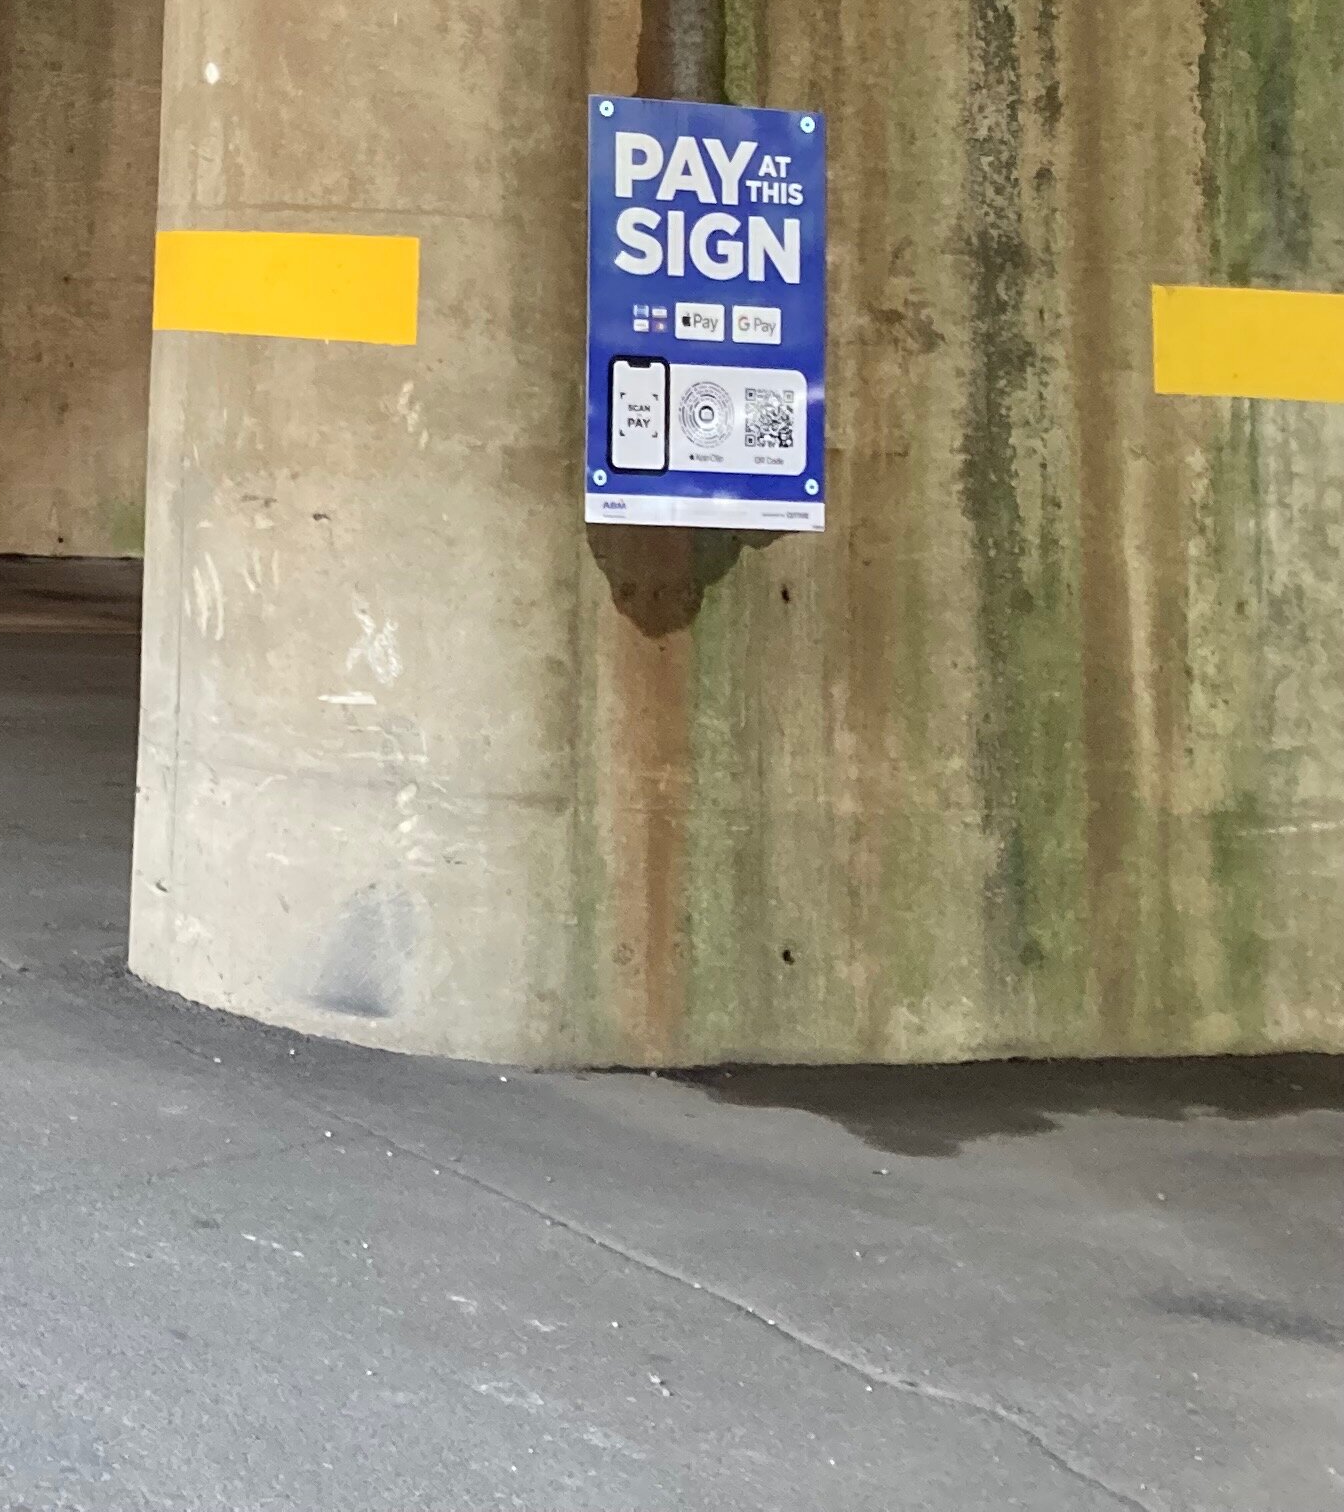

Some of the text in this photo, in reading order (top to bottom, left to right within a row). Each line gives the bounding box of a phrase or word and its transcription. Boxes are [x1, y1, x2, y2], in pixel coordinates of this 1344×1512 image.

[615, 131, 792, 205] PAY AT
[745, 180, 804, 205] THIS
[614, 207, 801, 284] SIGN
[693, 313, 720, 332] Pay
[754, 317, 777, 337] Pay
[627, 403, 651, 413] SCAN
[627, 417, 651, 429] PAY
